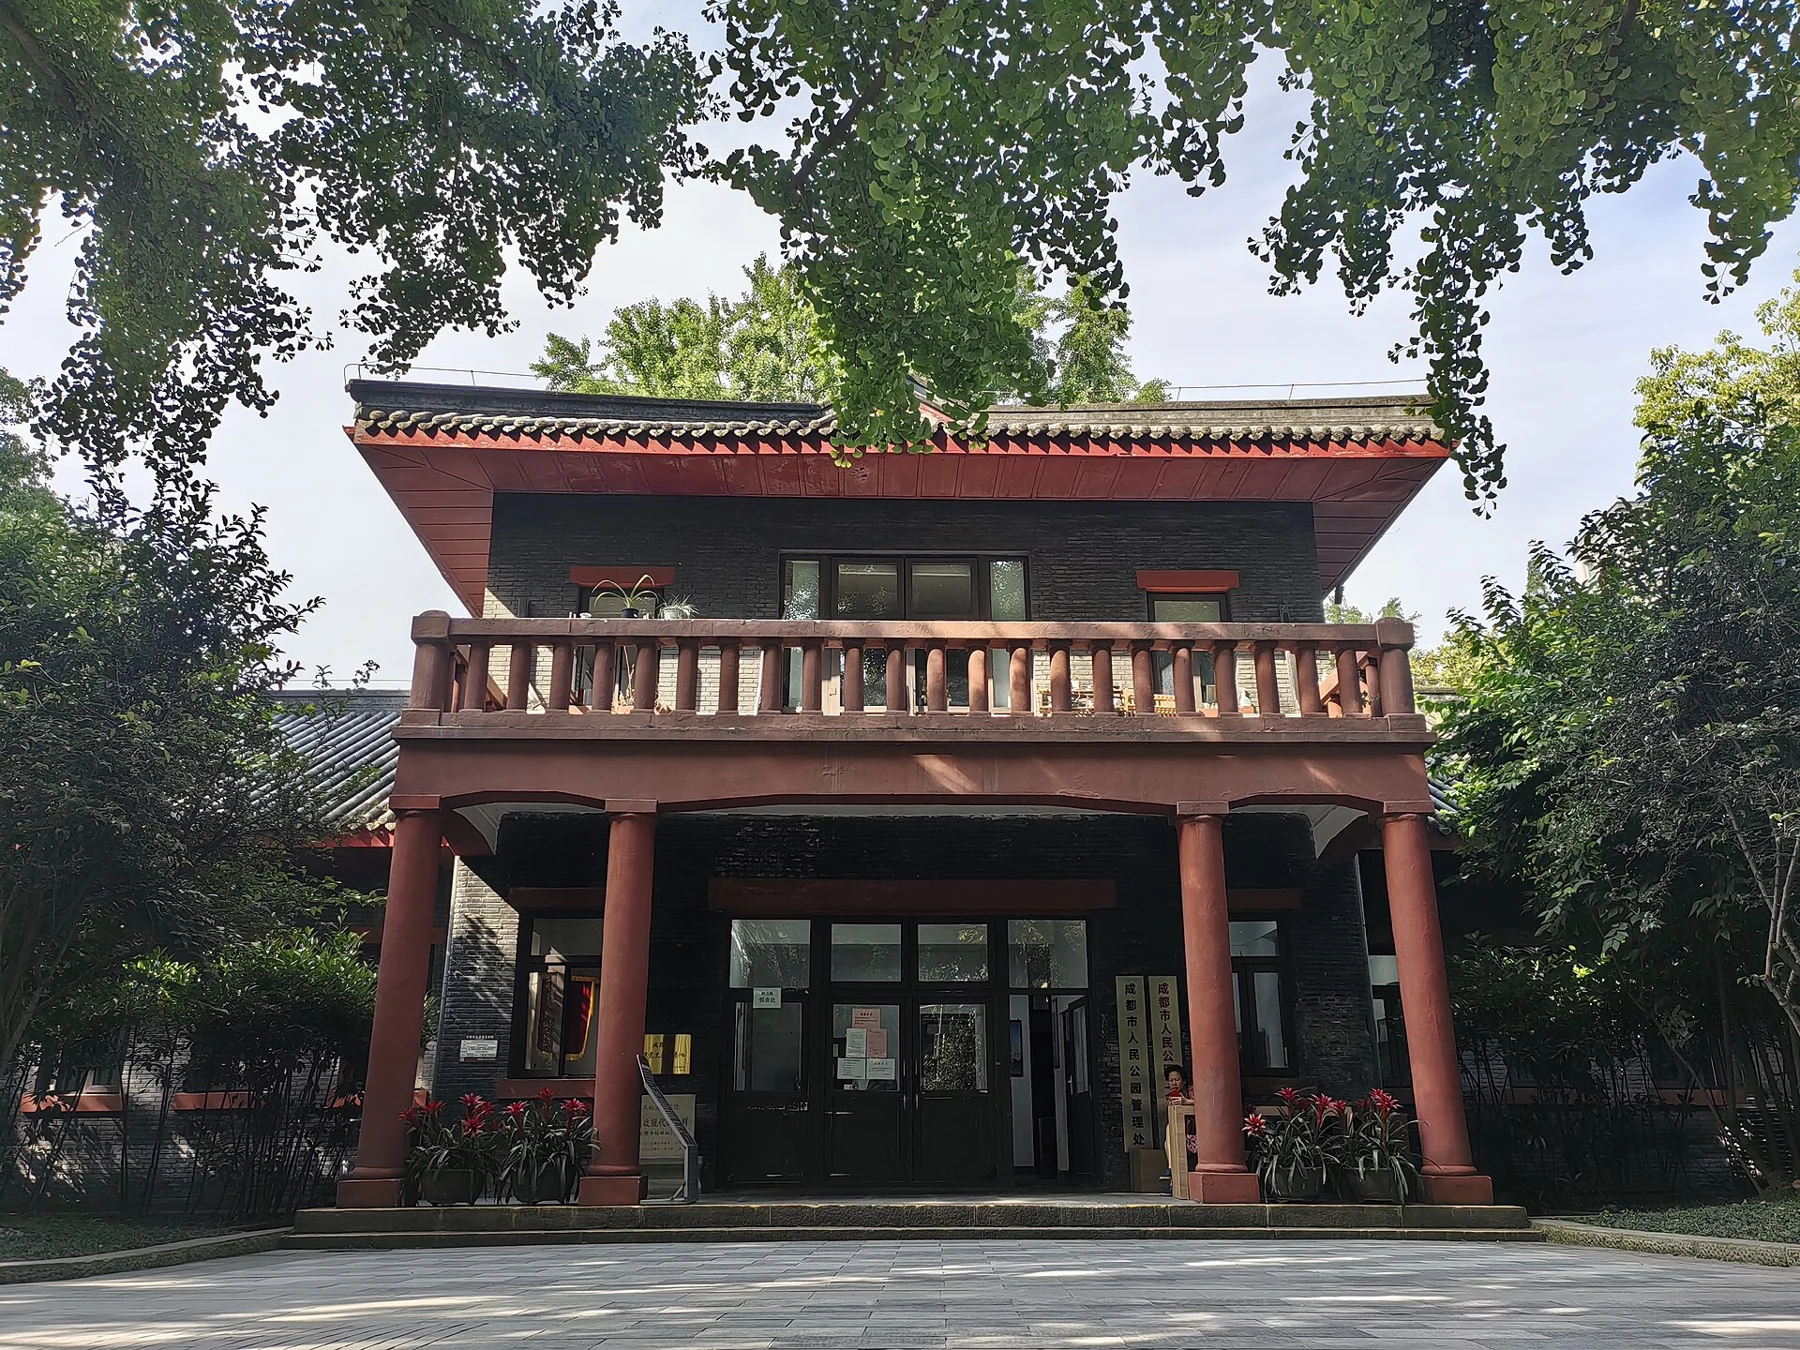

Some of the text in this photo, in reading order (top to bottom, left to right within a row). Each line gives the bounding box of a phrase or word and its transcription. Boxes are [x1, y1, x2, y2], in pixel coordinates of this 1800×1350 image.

[1124, 982, 1146, 1146] 成都市人民公园管理处
[1157, 982, 1175, 1092] 成都市人民公
